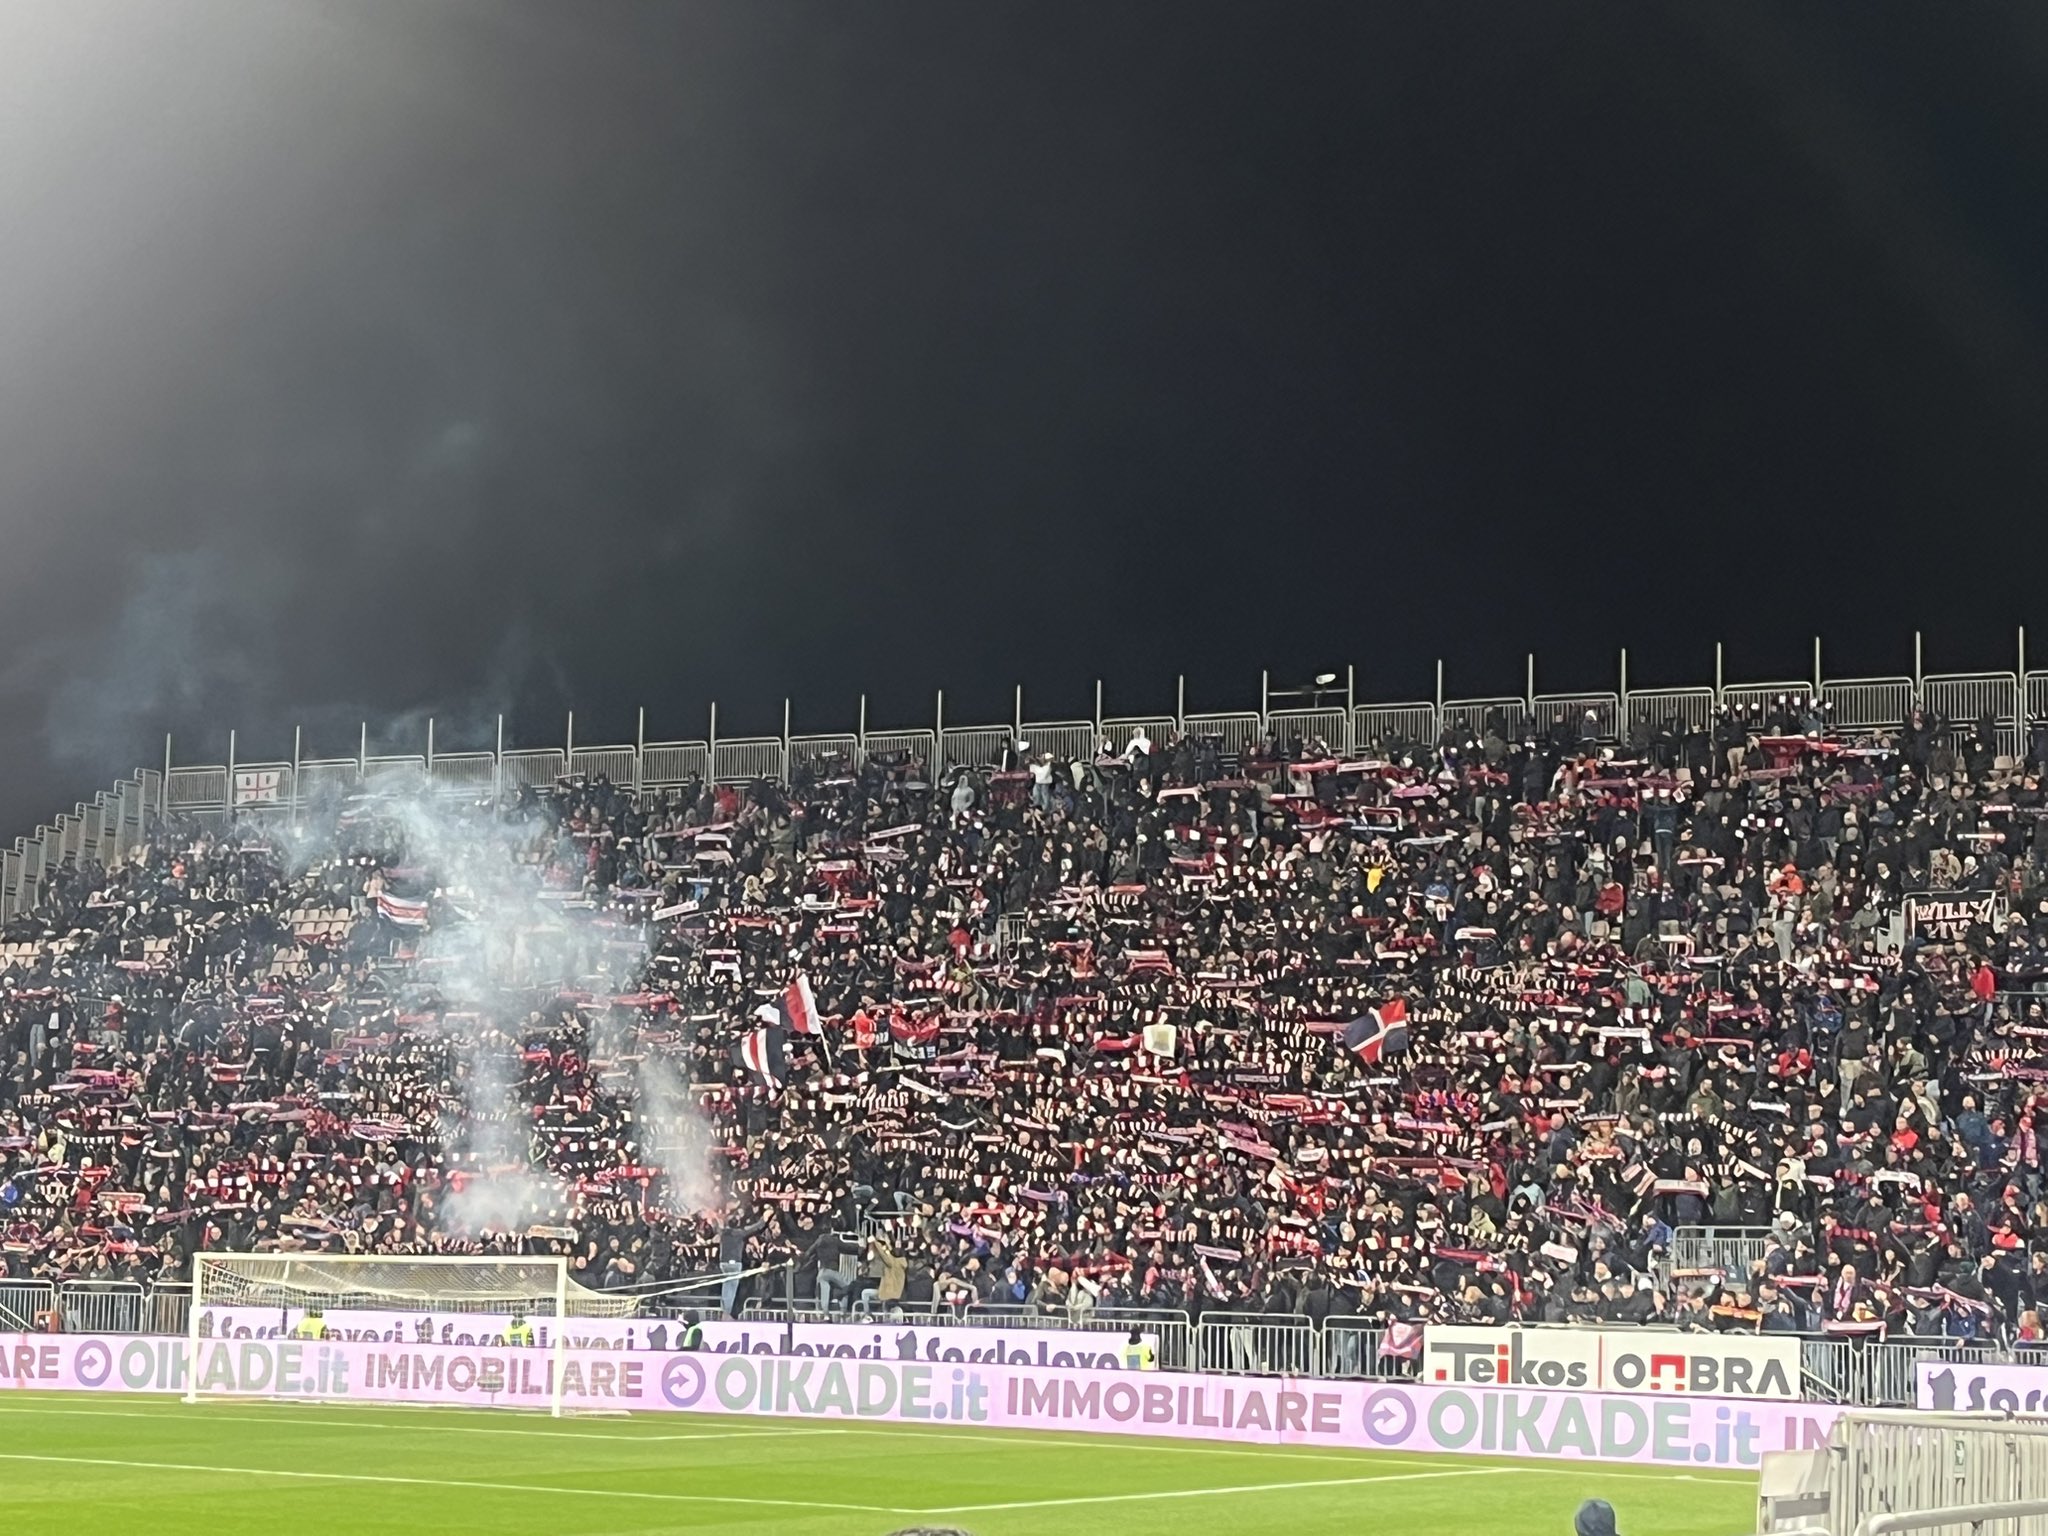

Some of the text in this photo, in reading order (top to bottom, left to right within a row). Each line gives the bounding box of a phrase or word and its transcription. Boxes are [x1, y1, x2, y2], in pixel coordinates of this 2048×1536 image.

[1916, 898, 1991, 921] WILLY
[364, 1353, 643, 1398] IMMOBILIARE
[715, 1356, 989, 1421] OIKADE.it
[1007, 1377, 1342, 1433] IMMOBILIARE
[1427, 1389, 1761, 1464] OIKADE.it
[1966, 1376, 2048, 1412] Sar
